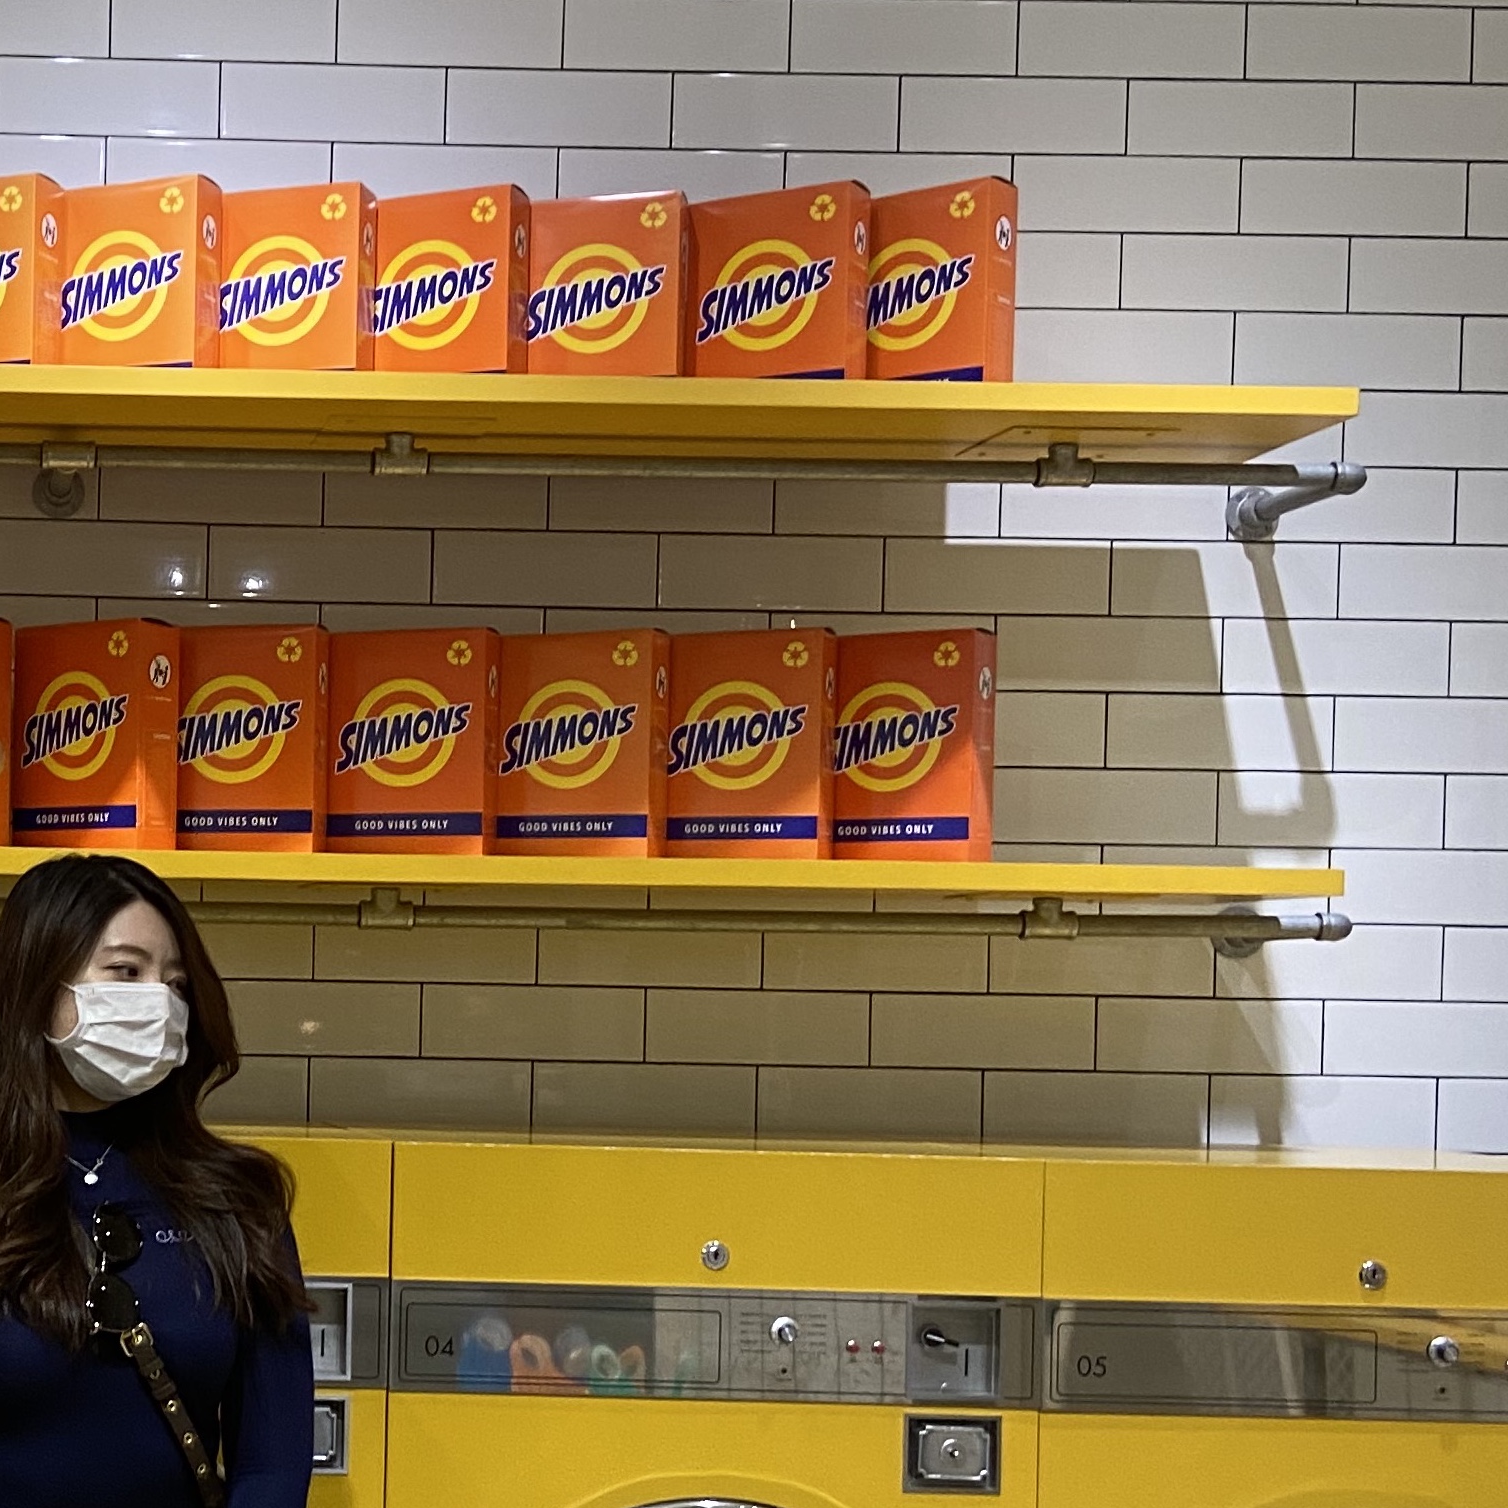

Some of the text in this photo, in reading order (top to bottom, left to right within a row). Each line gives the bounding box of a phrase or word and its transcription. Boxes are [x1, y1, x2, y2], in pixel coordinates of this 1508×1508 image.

[59, 251, 182, 330] SIMMONS
[218, 258, 345, 332] SIMMONS
[525, 266, 666, 343] SIMMONS
[696, 258, 835, 344] SIMMONS
[865, 255, 974, 332] MMONS
[21, 695, 128, 769] SIMMONS
[335, 703, 472, 773] SIMMONS
[499, 705, 637, 775] SIMMONS
[667, 706, 807, 777] SIMMONS
[832, 706, 958, 773] IMMONS
[35, 811, 110, 825] GOOD VIBES ONLY
[184, 815, 279, 828] GOOD VIBES ONLY
[354, 818, 449, 832] GOOD VIBES ONLY
[518, 820, 614, 833] GOOD VIBES ONLY
[684, 821, 783, 835] GOOD VIBES ONLY
[837, 822, 935, 837] GOOD VIBES ONLY
[424, 1335, 454, 1357] 04
[1076, 1355, 1107, 1378] 05
